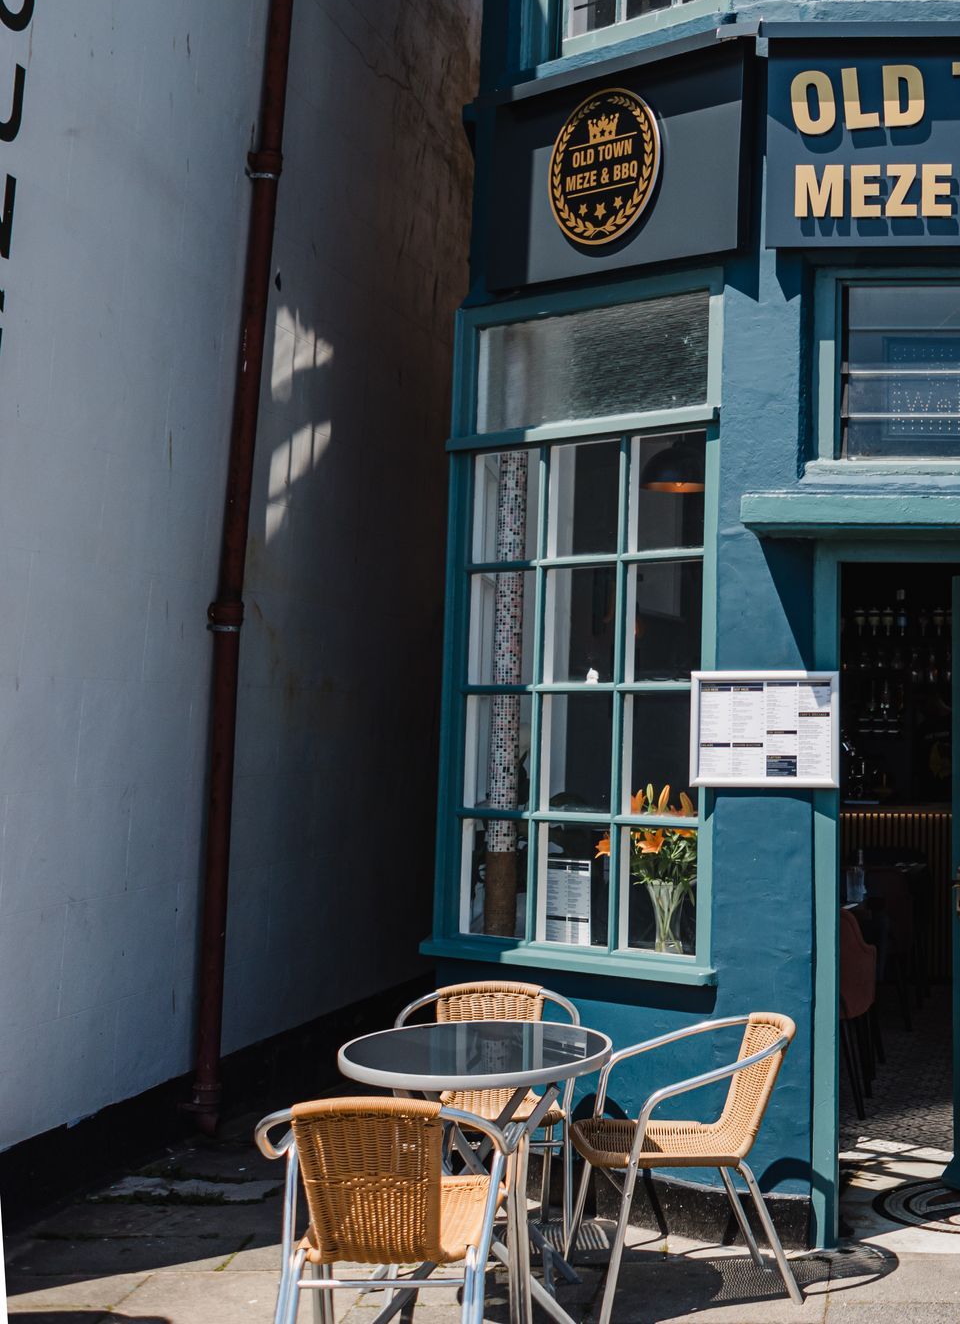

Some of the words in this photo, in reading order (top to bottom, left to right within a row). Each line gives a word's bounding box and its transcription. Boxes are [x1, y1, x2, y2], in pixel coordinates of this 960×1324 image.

[790, 63, 925, 135] OLD
[572, 148, 595, 169] OLD
[598, 139, 633, 162] TOWN
[566, 170, 597, 193] MEZE
[600, 167, 610, 184] &
[613, 160, 639, 182] BBQ
[794, 163, 953, 218] MEZE
